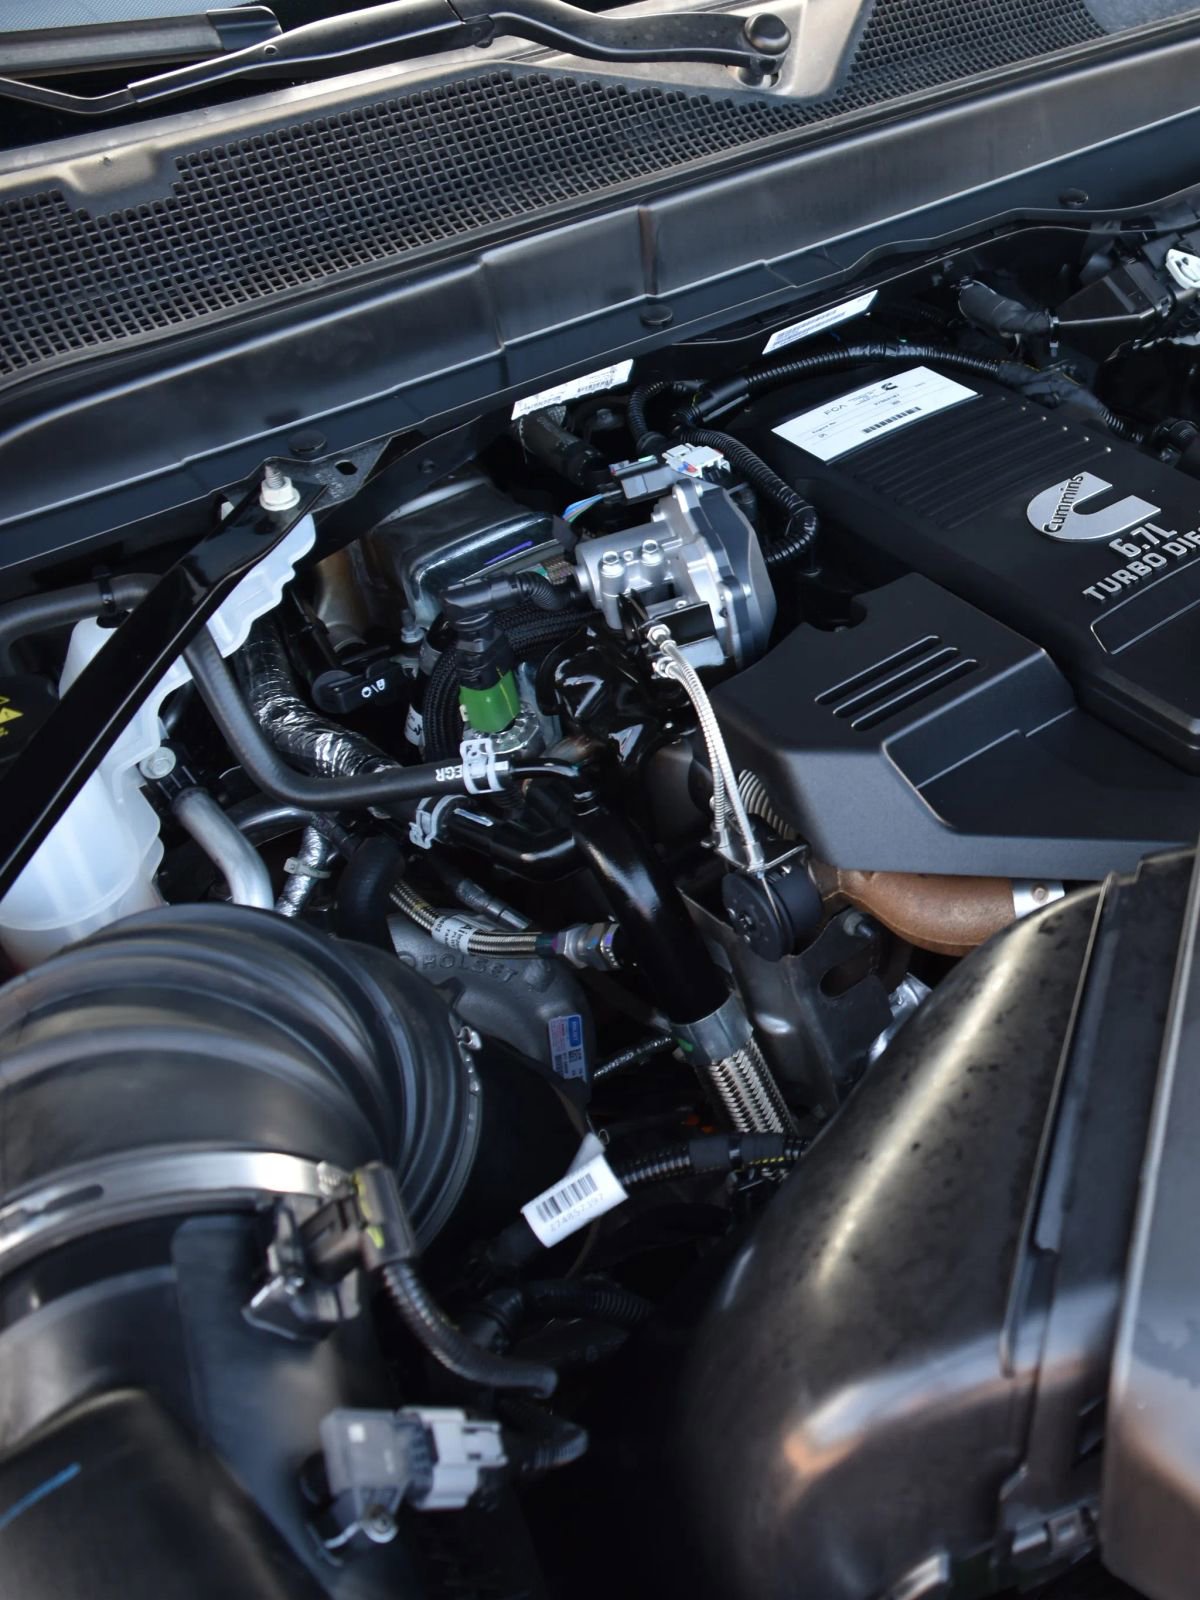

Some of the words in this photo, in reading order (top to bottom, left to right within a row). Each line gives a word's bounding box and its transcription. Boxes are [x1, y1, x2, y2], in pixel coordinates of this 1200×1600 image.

[1042, 475, 1083, 533] Cummins
[1108, 522, 1178, 558] 6.7L
[1082, 552, 1168, 602] TURBO
[435, 764, 464, 782] EGR
